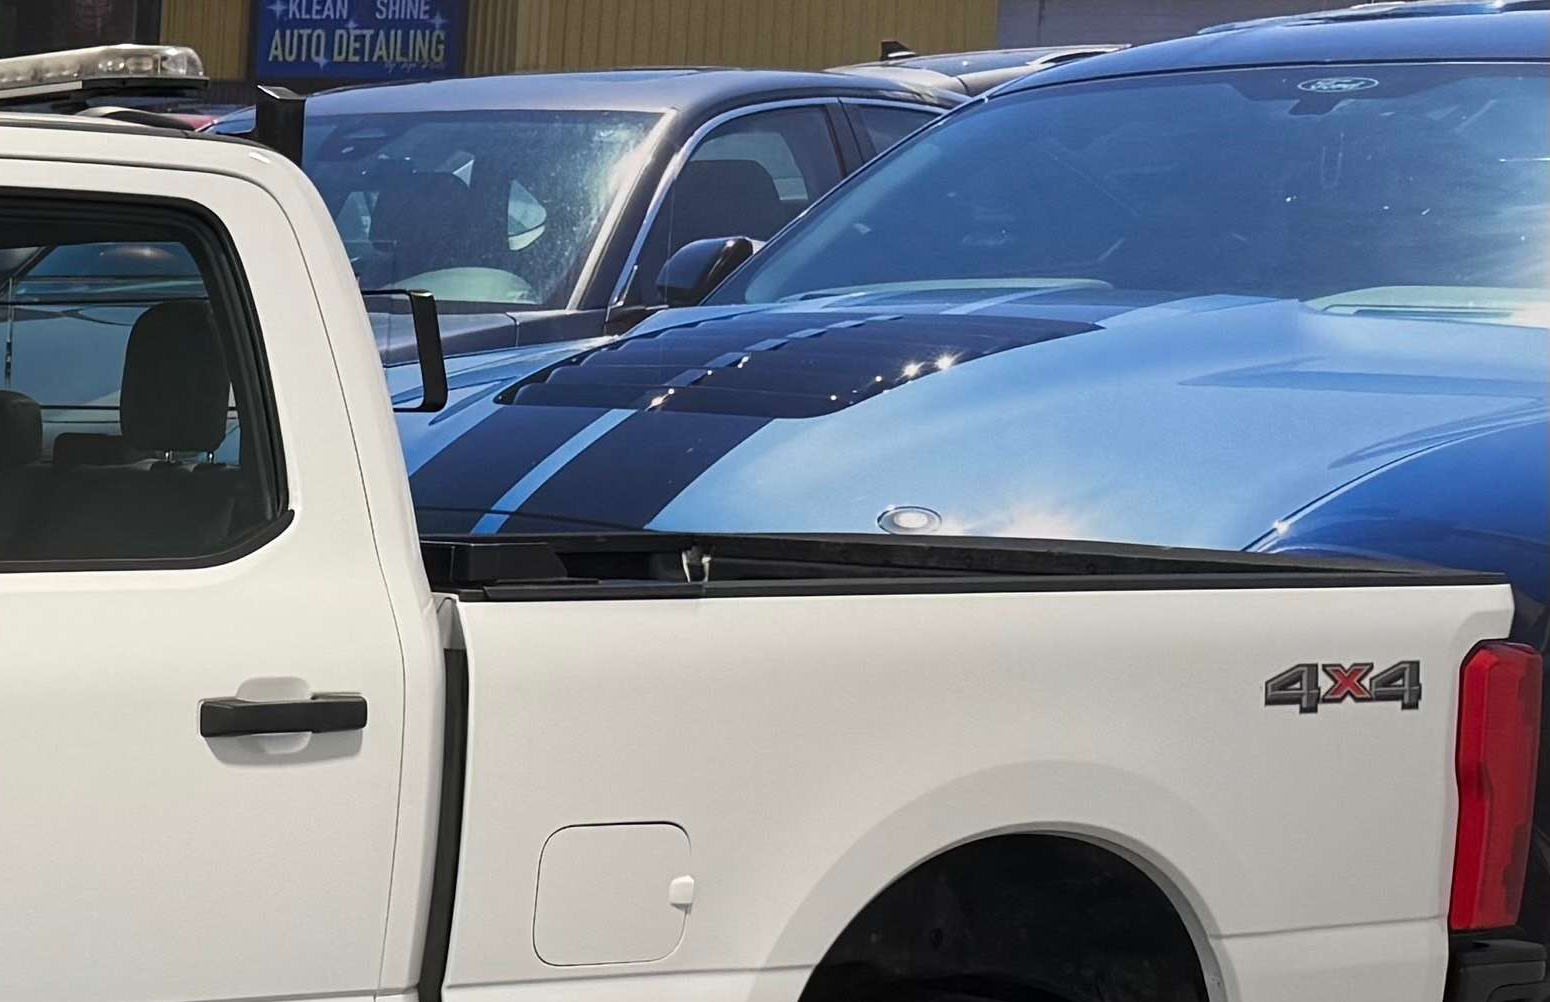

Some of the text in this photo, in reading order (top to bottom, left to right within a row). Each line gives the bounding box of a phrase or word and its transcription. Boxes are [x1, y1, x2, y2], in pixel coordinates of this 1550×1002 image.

[289, 0, 430, 20] KLEAN SHINE
[268, 28, 447, 62] AUTO DETAILING
